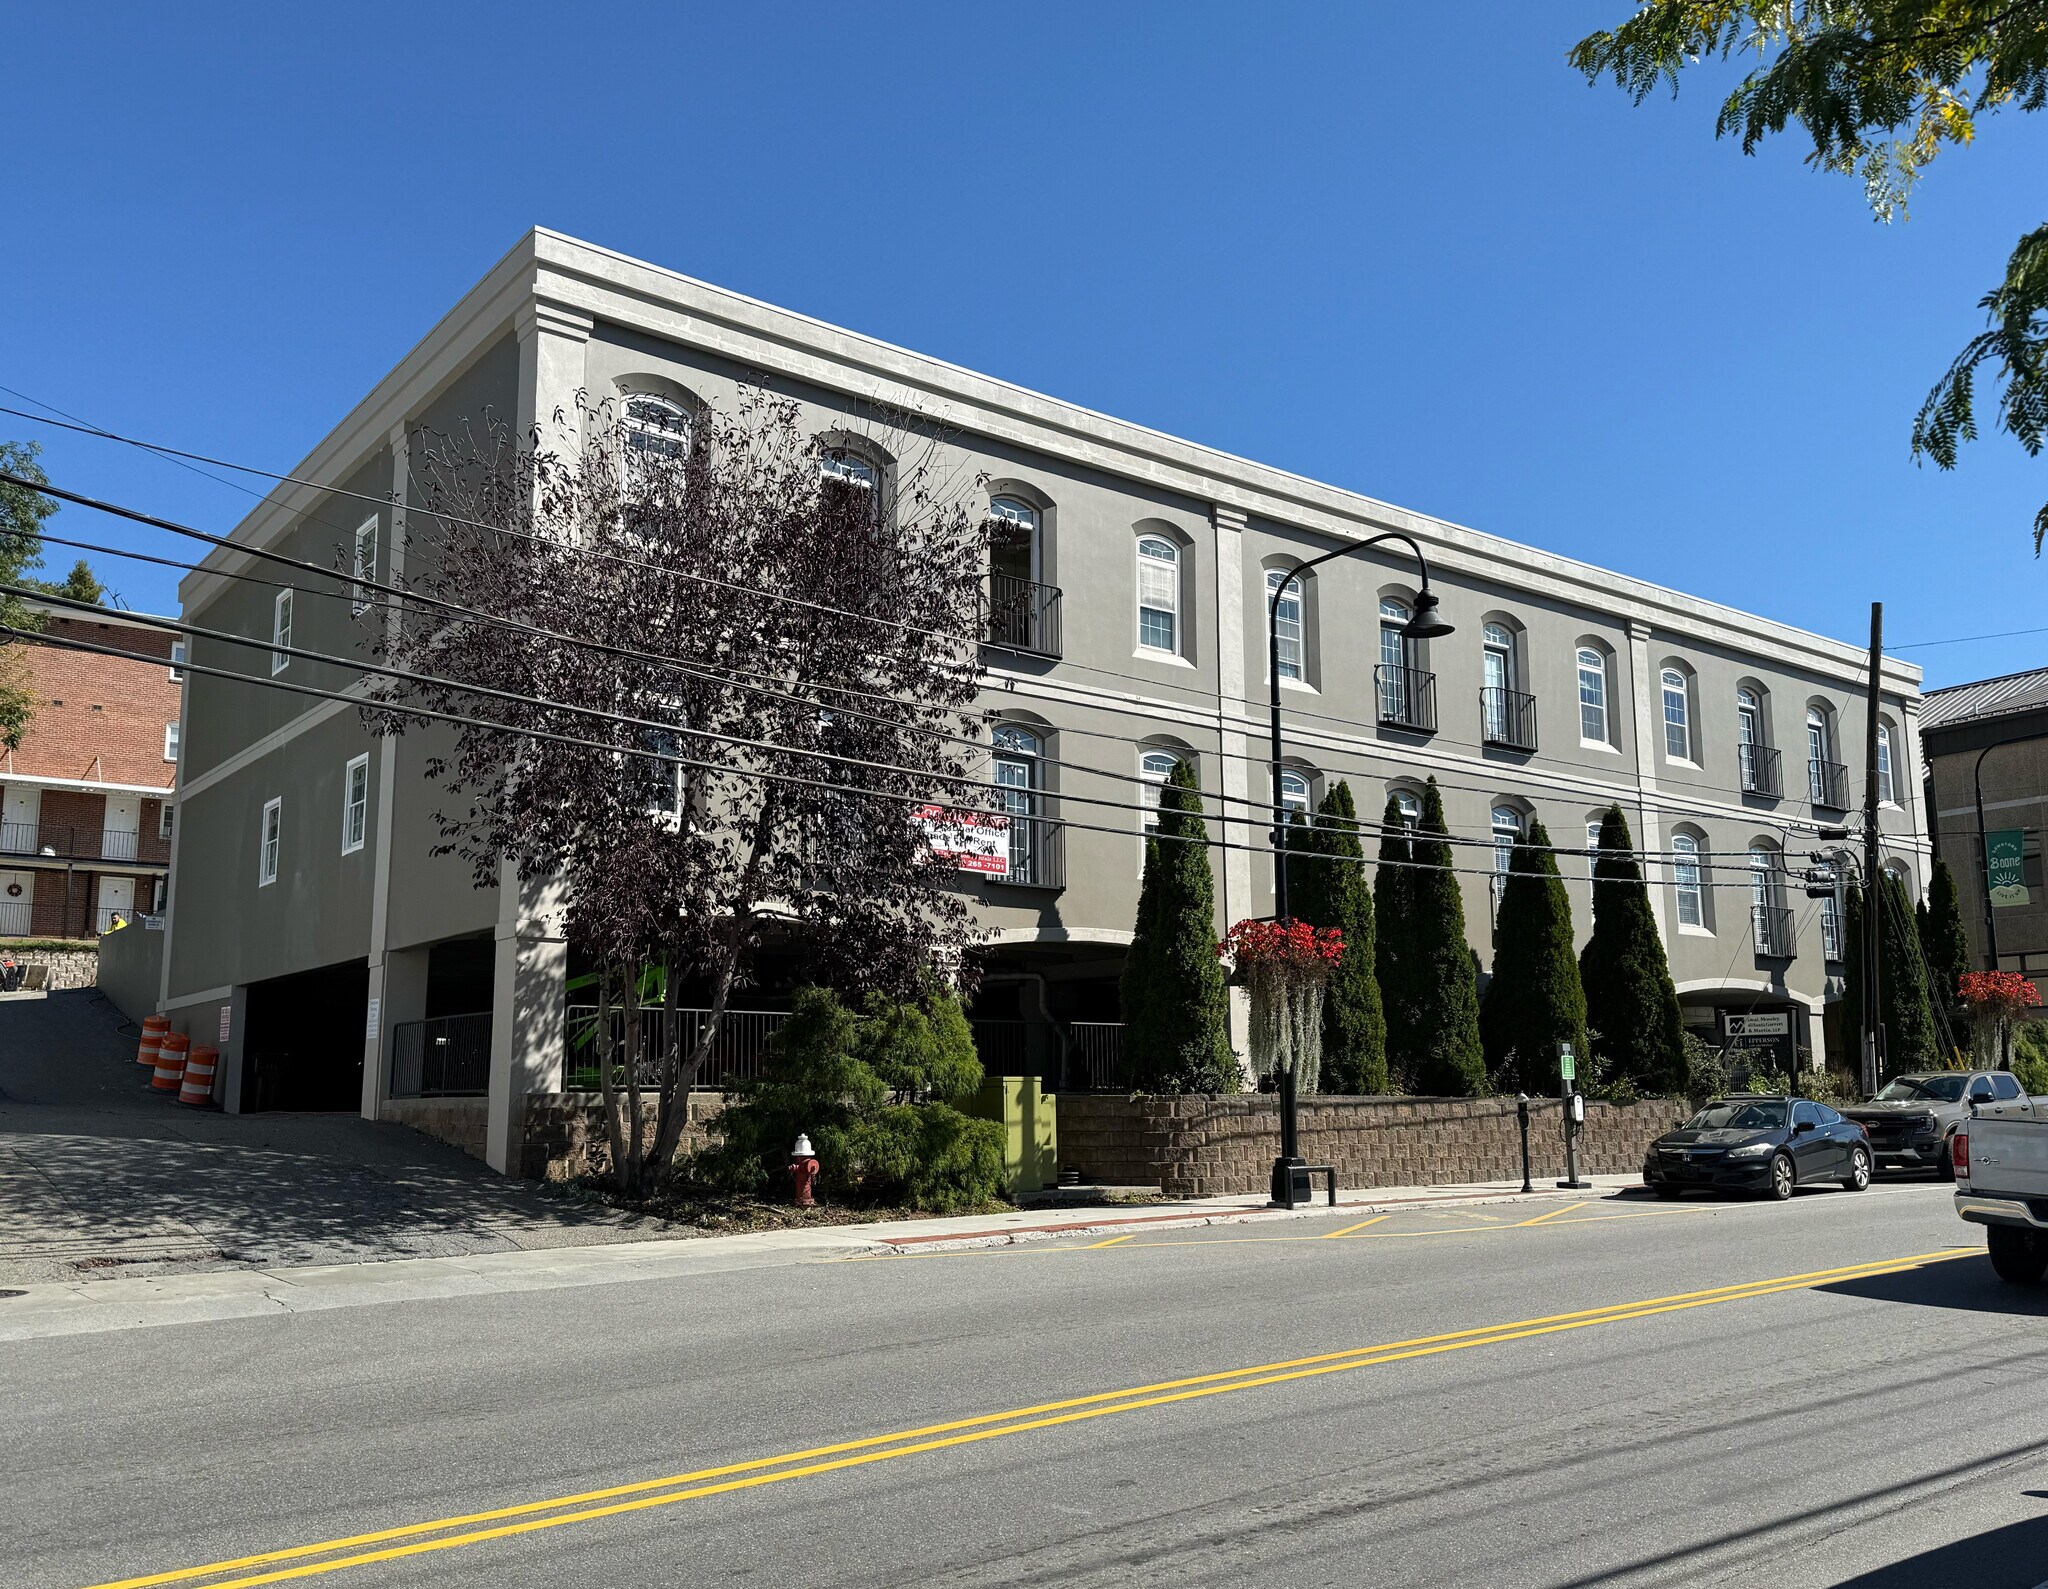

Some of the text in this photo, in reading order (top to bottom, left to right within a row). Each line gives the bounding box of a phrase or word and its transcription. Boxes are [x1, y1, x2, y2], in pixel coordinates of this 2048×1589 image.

[976, 827, 1006, 838] Office
[973, 836, 996, 846] Rent
[968, 860, 982, 868] 265
[1990, 856, 2020, 870] Boone
